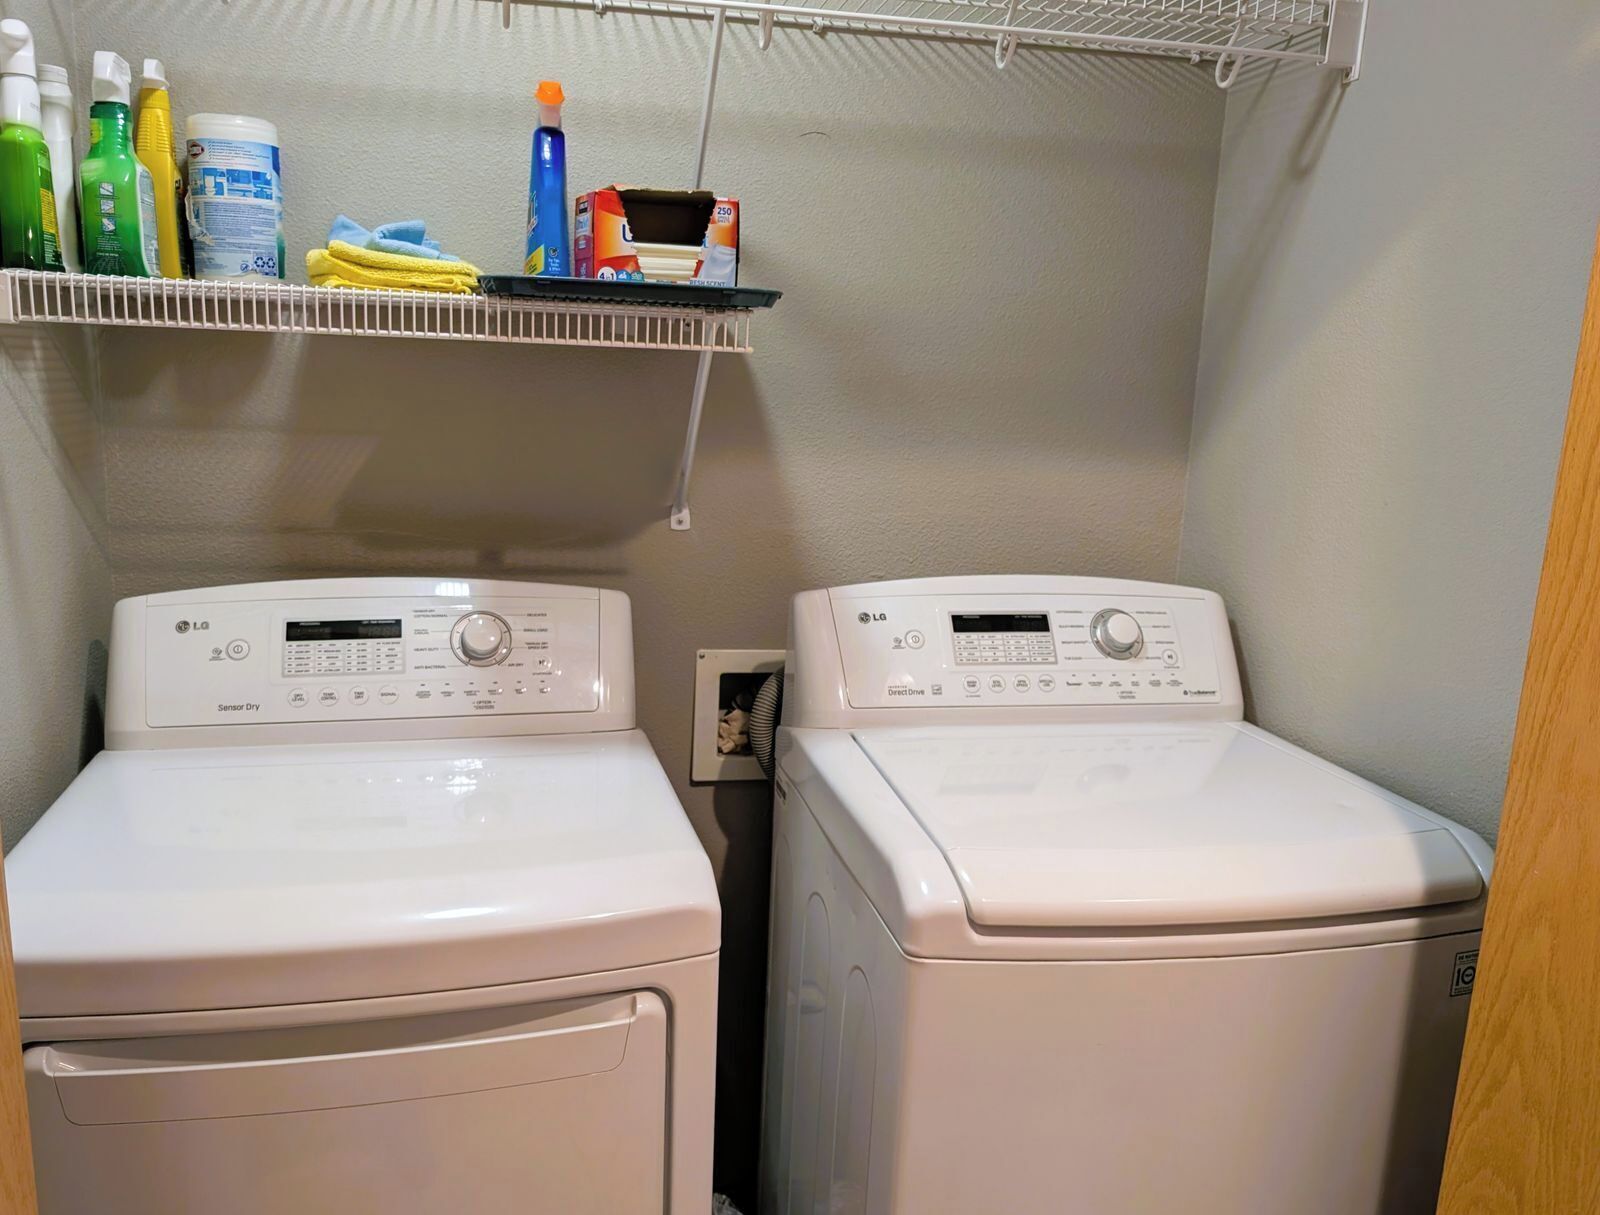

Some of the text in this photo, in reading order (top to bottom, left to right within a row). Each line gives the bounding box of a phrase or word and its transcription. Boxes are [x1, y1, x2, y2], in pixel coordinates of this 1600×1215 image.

[717, 207, 732, 216] 250
[872, 613, 887, 622] LG
[193, 621, 210, 631] LG
[218, 703, 260, 712] Sensor Dry
